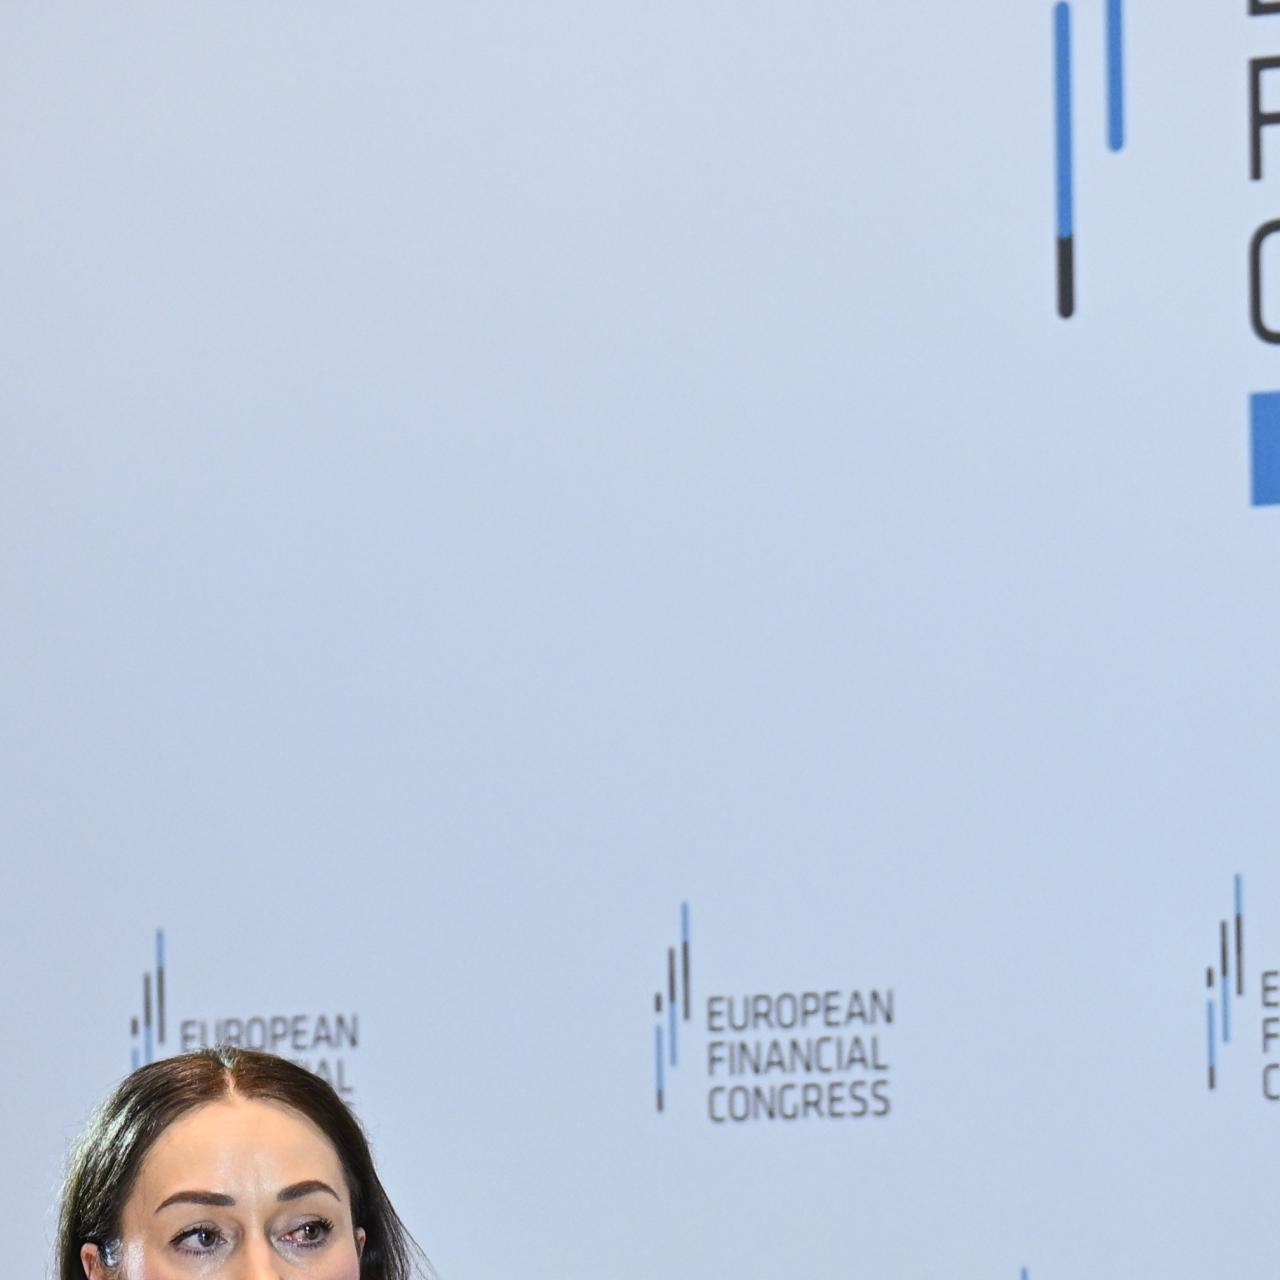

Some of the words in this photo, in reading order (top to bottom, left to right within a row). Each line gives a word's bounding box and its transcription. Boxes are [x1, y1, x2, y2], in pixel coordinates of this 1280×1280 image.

[706, 988, 894, 1032] EUROPEAN
[180, 1012, 359, 1051] EUROPEAN
[707, 1036, 890, 1077] FINANCIAL
[707, 1079, 892, 1124] CONGRESS
